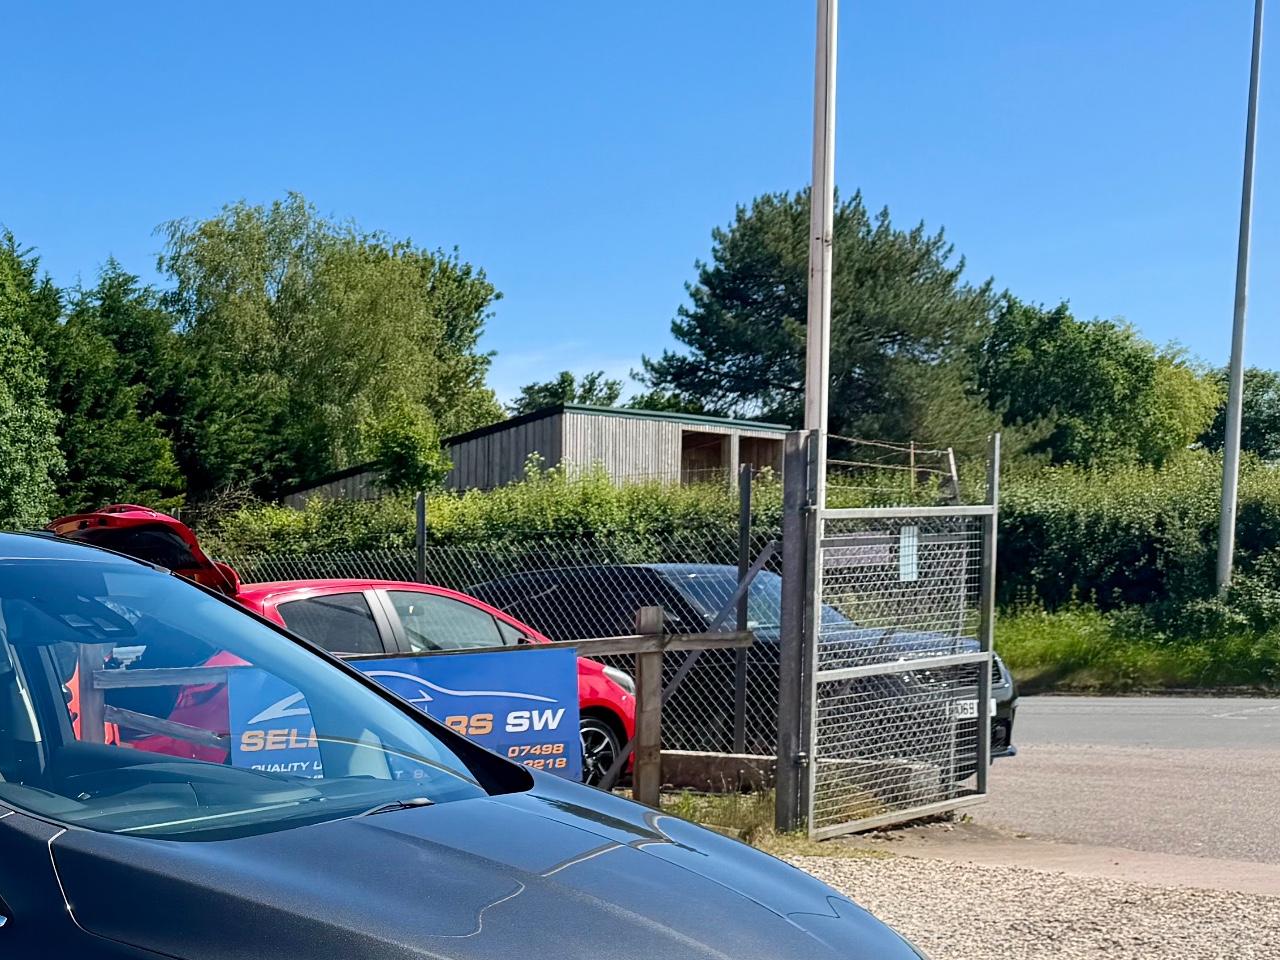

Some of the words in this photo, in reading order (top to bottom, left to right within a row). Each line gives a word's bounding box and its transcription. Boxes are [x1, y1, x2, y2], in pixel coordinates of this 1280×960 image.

[446, 714, 493, 736] RS
[505, 708, 566, 733] SW
[508, 743, 564, 758] 07498
